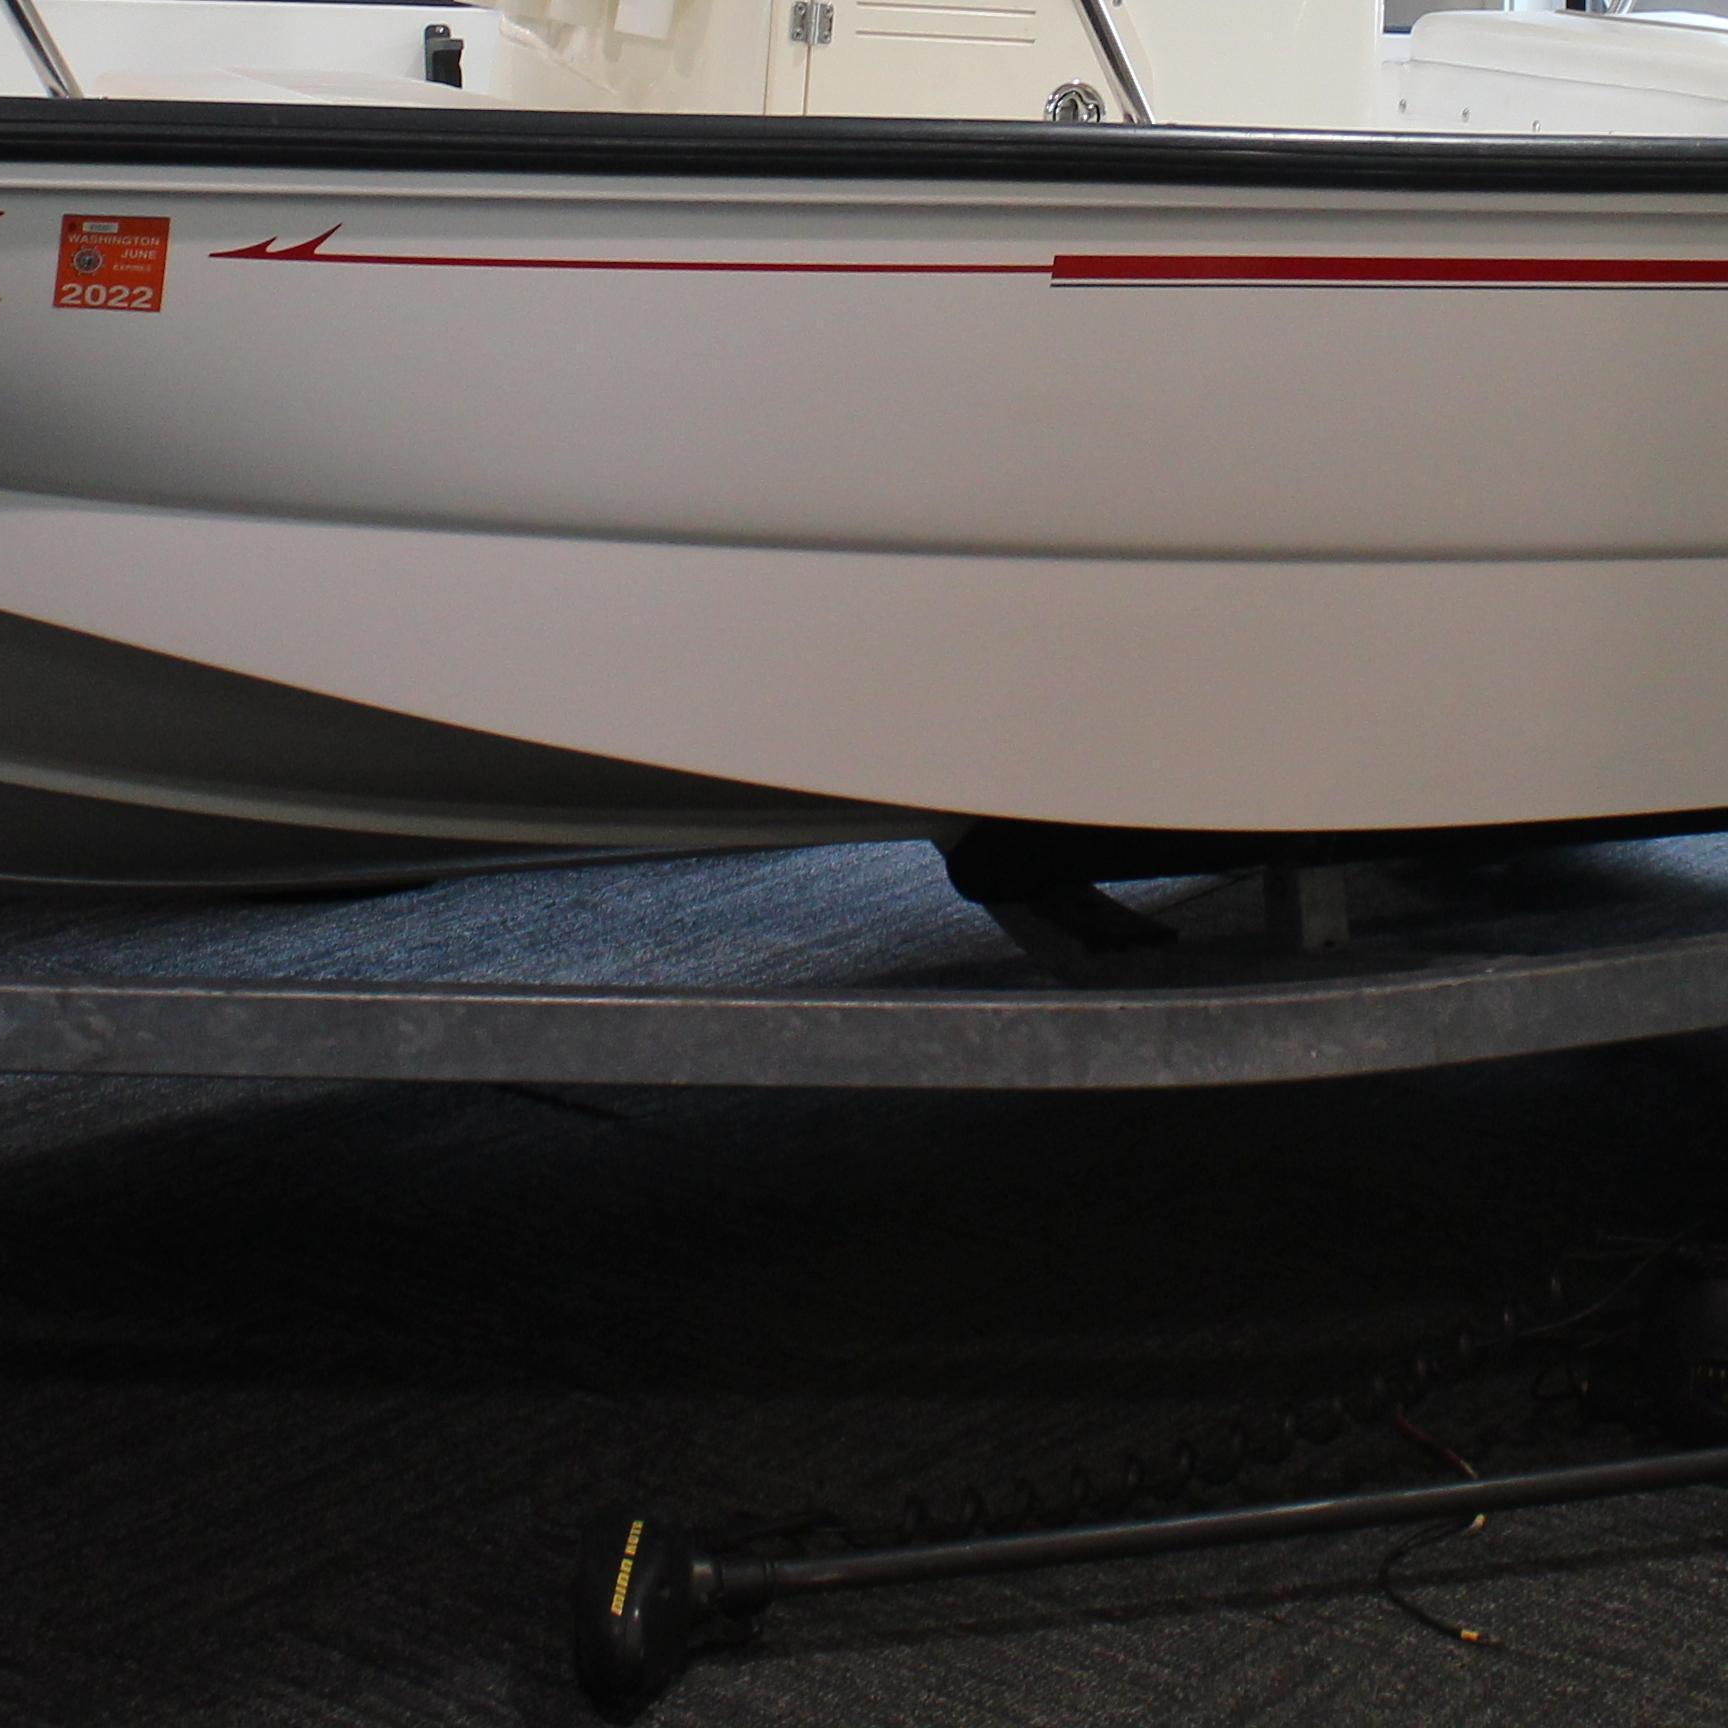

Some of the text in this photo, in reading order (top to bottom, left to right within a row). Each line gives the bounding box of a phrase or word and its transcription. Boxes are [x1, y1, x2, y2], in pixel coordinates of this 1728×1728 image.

[68, 234, 161, 246] WASHINGTON
[120, 249, 157, 260] JUNE
[59, 283, 153, 308] 2022
